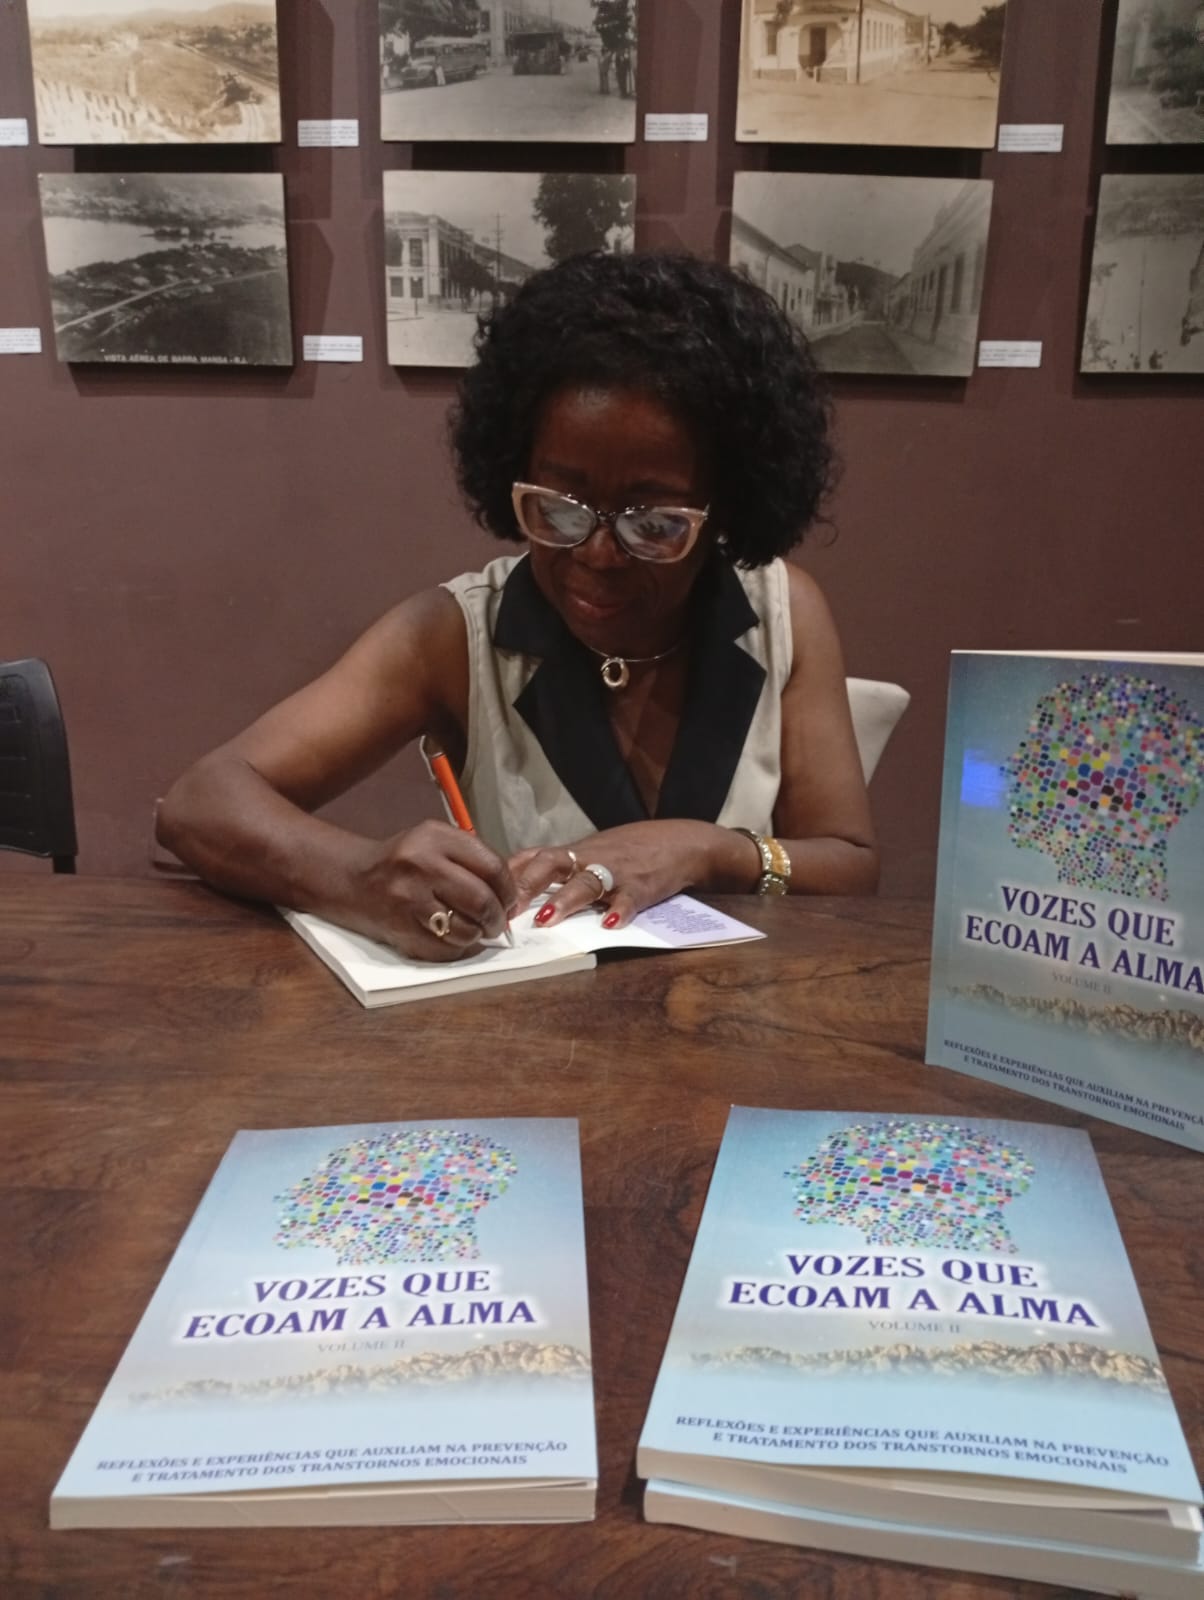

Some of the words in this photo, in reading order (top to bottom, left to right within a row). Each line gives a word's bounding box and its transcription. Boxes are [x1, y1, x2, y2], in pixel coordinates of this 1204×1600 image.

[1001, 886, 1096, 929] VOZES
[1107, 908, 1175, 947] QUE
[965, 915, 1071, 961] ECOAM
[1079, 942, 1101, 969] A
[1112, 949, 1204, 995] ALMA
[1052, 972, 1098, 992] VOLUME
[944, 1039, 991, 1059] REFLEXÕES
[1000, 1055, 1064, 1081] EXPERIÊNCIAS
[1065, 1075, 1085, 1088] QUE
[1086, 1082, 1134, 1103] AUXILIAM
[1135, 1098, 1150, 1109] NA
[964, 1055, 970, 1063] E
[971, 1057, 1030, 1081] TRATAMENTO
[1032, 1075, 1051, 1088] DOS
[1053, 1082, 1122, 1110] TRANSTORNOS
[1123, 1105, 1185, 1131] EMOCIONAIS
[253, 1275, 387, 1302] VOZES
[402, 1270, 491, 1297] QUE
[786, 1254, 925, 1278] VOZES
[942, 1260, 1039, 1287] QUE
[183, 1308, 349, 1339] ECOAM
[360, 1306, 391, 1329] A
[406, 1301, 537, 1327] ALMA
[729, 1281, 891, 1309] ECOAM
[908, 1288, 940, 1311] A
[957, 1292, 1100, 1328] ALMA
[868, 1320, 946, 1333] VOLUME
[949, 1322, 962, 1334] II
[317, 1341, 388, 1352] VOLUME
[97, 1456, 189, 1471] REFLEXÕES
[192, 1457, 203, 1467] E
[207, 1449, 321, 1467] EXPERIÊNCIAS
[325, 1447, 359, 1460] QUE
[362, 1444, 441, 1457] AUXILIAM
[444, 1443, 468, 1453] NA
[472, 1440, 568, 1455] PREVENÇÃO
[676, 1416, 765, 1434] REFLEXÕES
[769, 1425, 780, 1434] E
[783, 1424, 901, 1439] EXPERIÊNCIAS
[904, 1428, 940, 1440] QUE
[944, 1431, 1028, 1448] AUXILIAM
[1033, 1439, 1057, 1451] NA
[1062, 1443, 1170, 1467] PREVENÇÃO
[713, 1432, 724, 1442] E
[727, 1433, 839, 1450] TRATAMENTO
[843, 1440, 878, 1451] DOS
[881, 1440, 1010, 1459] TRANSTORNOS
[1015, 1451, 1128, 1474] EMOCIONAIS
[131, 1473, 142, 1483] E
[147, 1466, 259, 1482] TRATAMENTO
[262, 1463, 296, 1475] DOS
[302, 1458, 421, 1473] TRANSTORNOS
[425, 1454, 528, 1467] EMOCIONAIS
